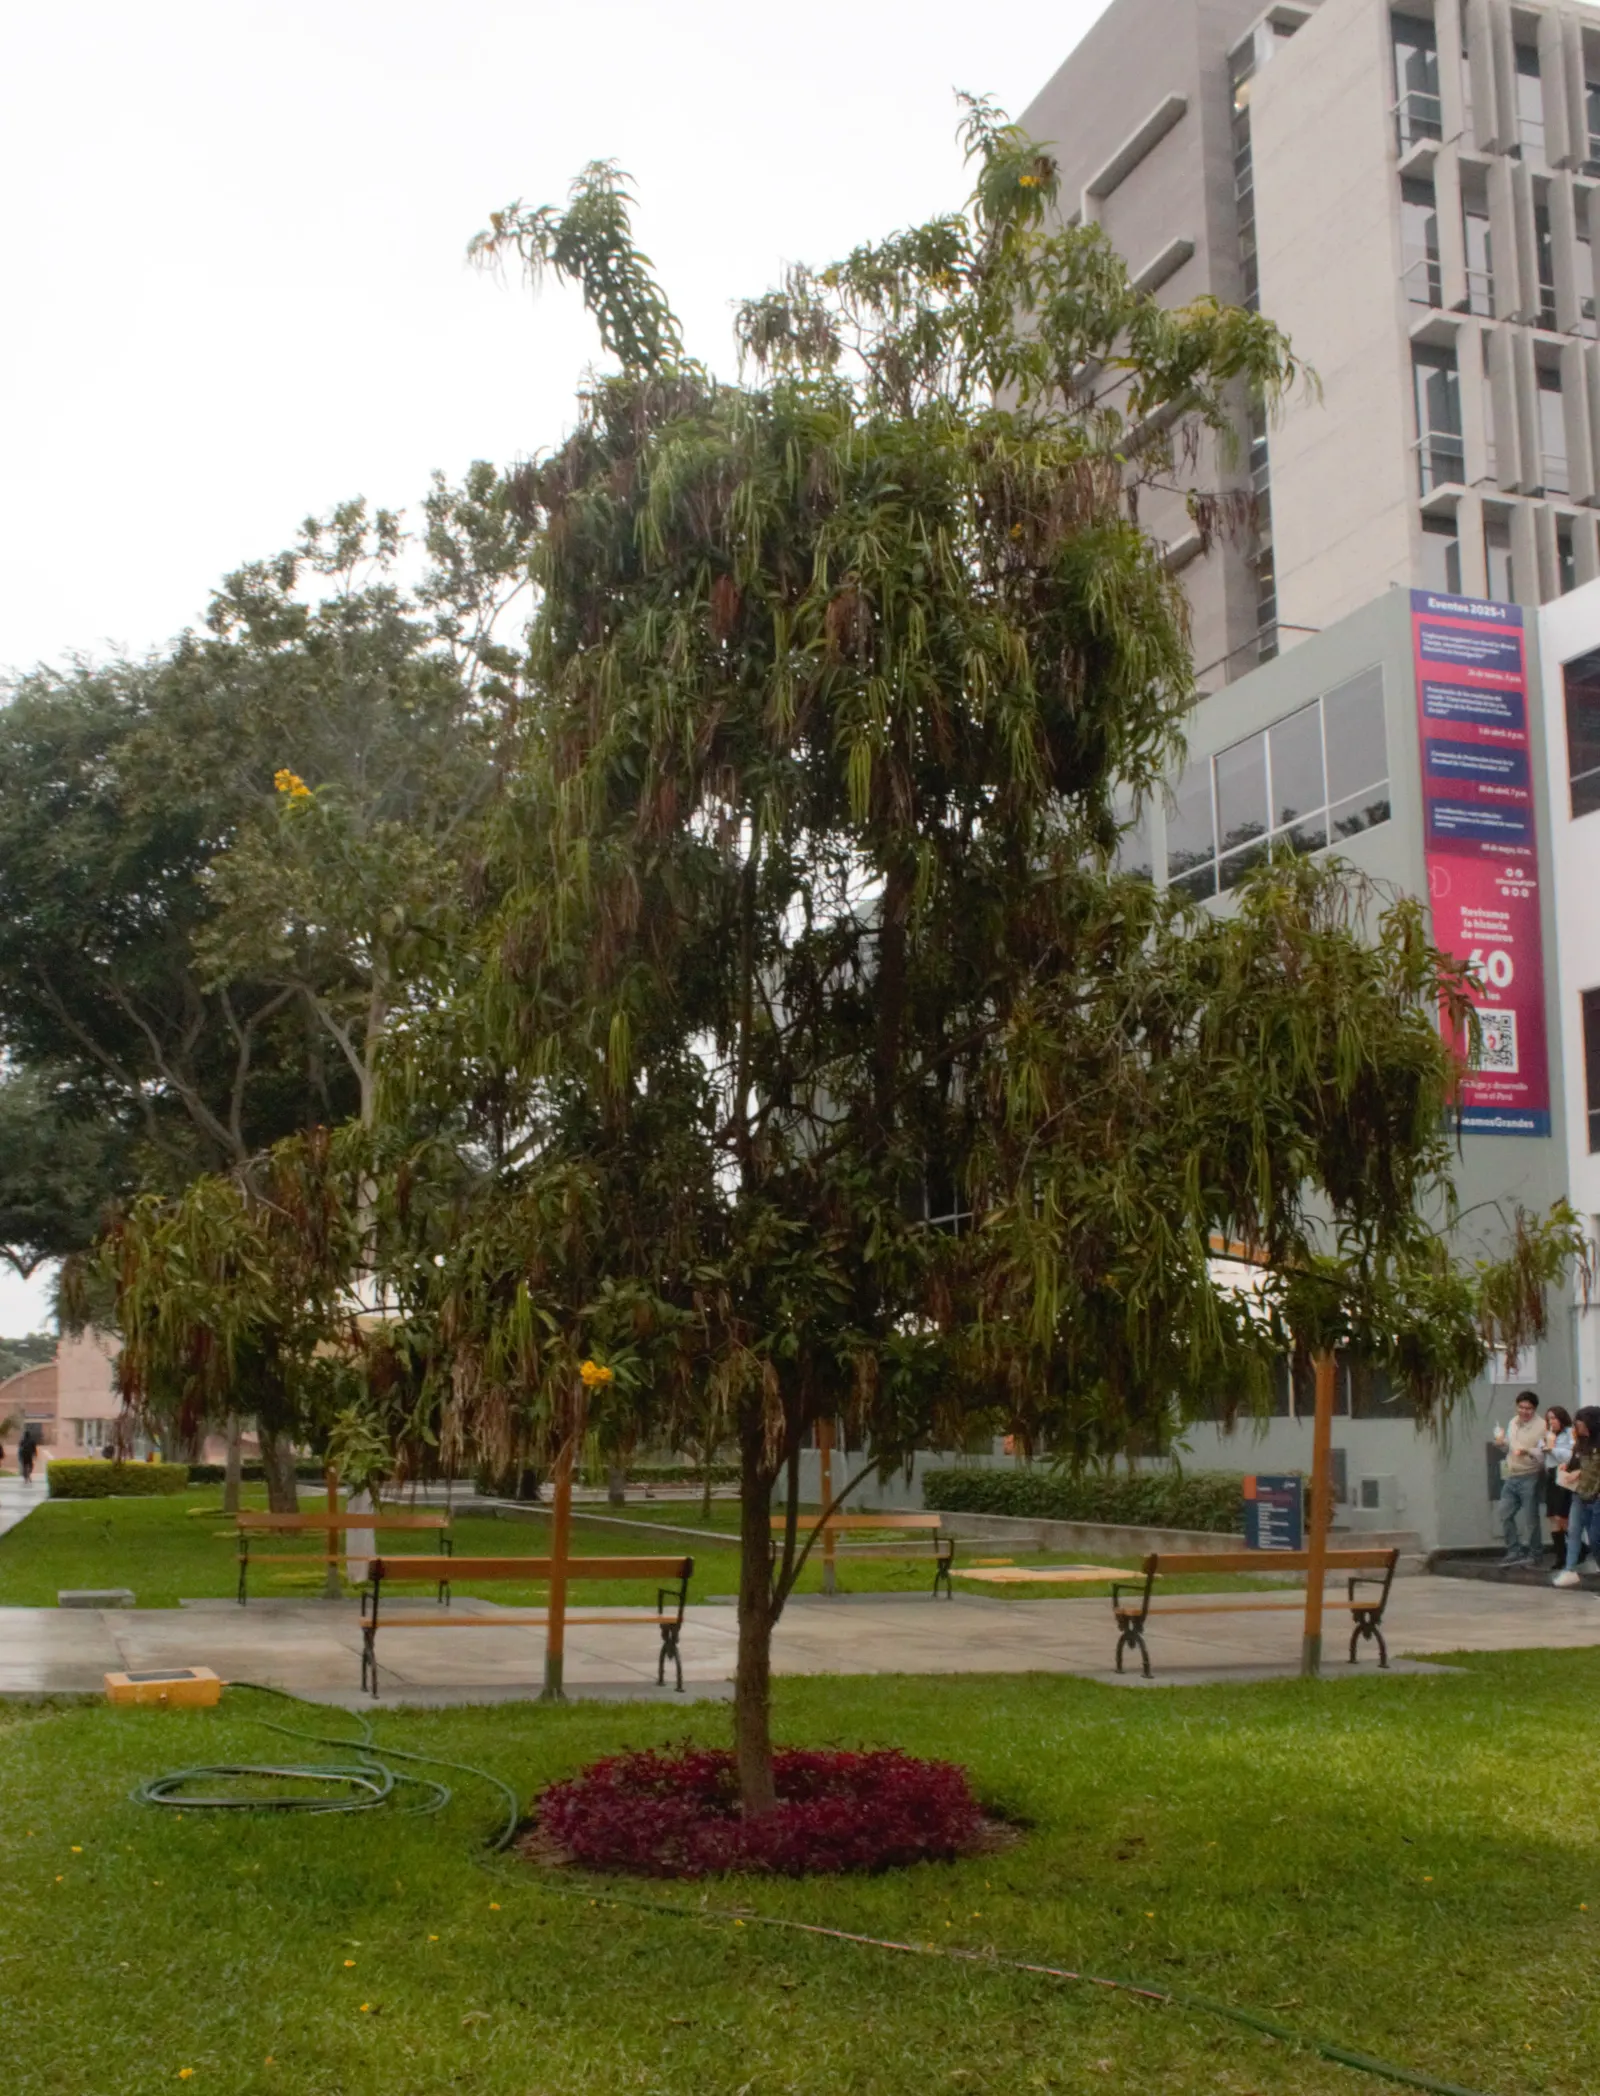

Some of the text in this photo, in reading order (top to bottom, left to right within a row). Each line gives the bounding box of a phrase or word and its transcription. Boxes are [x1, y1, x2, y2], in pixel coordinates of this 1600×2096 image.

[1428, 596, 1506, 619] Eventos 2025-1
[1460, 906, 1510, 920] Revivamos
[1463, 918, 1508, 931] la historia
[1460, 929, 1514, 943] de nuestros
[1465, 948, 1514, 988] 60
